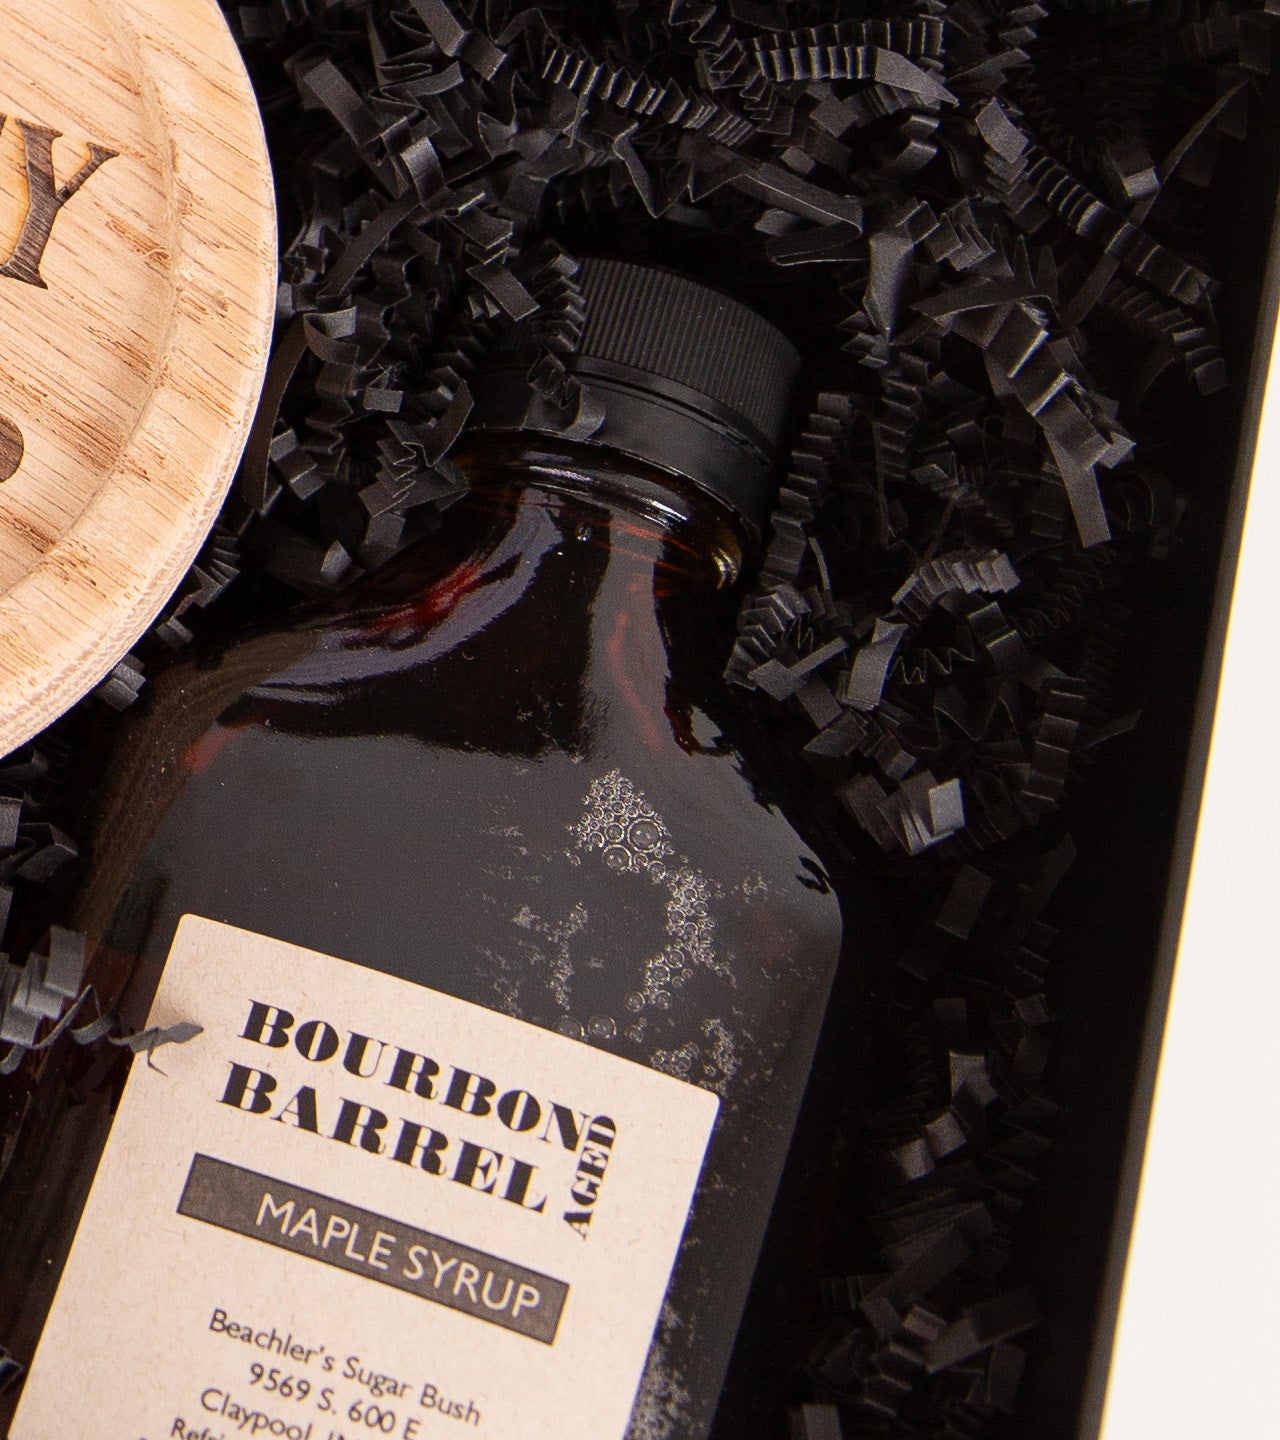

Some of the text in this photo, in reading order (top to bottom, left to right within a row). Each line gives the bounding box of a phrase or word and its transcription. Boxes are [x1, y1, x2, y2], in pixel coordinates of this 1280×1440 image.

[217, 1061, 548, 1215] BARREL
[237, 998, 593, 1153] BOURBON
[563, 1114, 617, 1241] AGED
[255, 1192, 541, 1318] MAPLE SYRUP
[208, 1308, 480, 1426] Beachler's Sugar Bush
[248, 1363, 311, 1402] 9569
[316, 1387, 336, 1416] S.
[347, 1401, 396, 1436] 600
